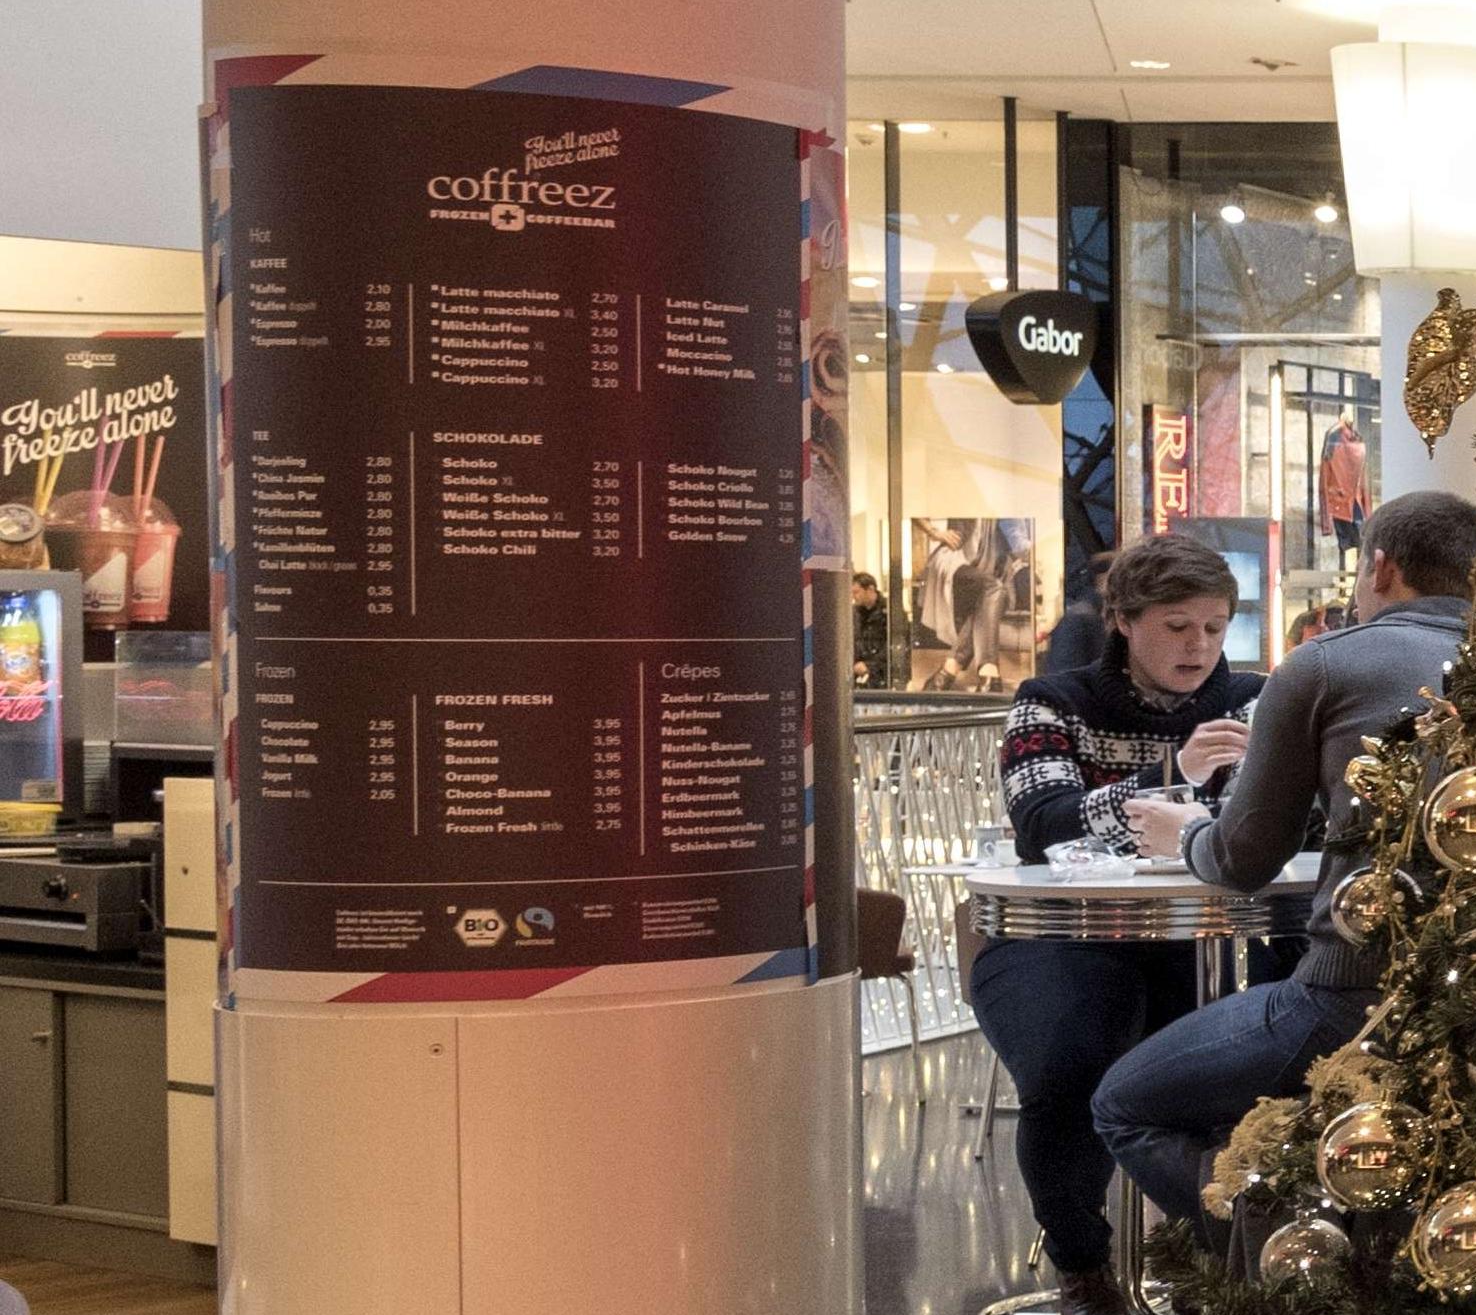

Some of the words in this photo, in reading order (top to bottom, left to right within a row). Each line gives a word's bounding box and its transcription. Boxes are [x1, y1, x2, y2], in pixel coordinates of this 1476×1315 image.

[427, 167, 617, 209] coffreez
[430, 208, 490, 221] FROZEN
[526, 213, 616, 229] COFFEEBAR
[250, 227, 272, 243] Hot
[250, 258, 288, 269] KAFFEE
[441, 286, 479, 298] Latte
[484, 287, 560, 301] macchiato
[666, 298, 699, 309] Latte
[441, 303, 479, 315] Latte
[484, 304, 560, 318] macchiato
[441, 319, 530, 334] Milchkaffee
[666, 315, 699, 326] Latte
[667, 331, 694, 342] Iced
[697, 333, 729, 345] Latte
[1018, 316, 1083, 357] Gabor
[441, 336, 530, 351] Milchkaffee
[441, 354, 529, 370] Cappuccino
[441, 371, 529, 387] Cappuccino
[1, 387, 103, 435] You'll
[105, 374, 178, 416] never
[2, 425, 98, 476] freeze
[102, 405, 177, 444] alone
[433, 432, 543, 445] SCHOKOLADE
[442, 457, 497, 470] Schoko
[668, 464, 715, 475] Schoko
[442, 474, 497, 487] Schoko
[668, 480, 715, 491] Schoko
[442, 492, 489, 504] Weiße
[493, 493, 549, 505] Schoko
[668, 497, 715, 508] Schoko
[442, 509, 489, 521] Weiße
[493, 510, 549, 522] Schoko
[668, 514, 715, 524] Schoko
[442, 526, 497, 539] Schoko
[500, 528, 539, 539] extra
[541, 528, 583, 539] bitter
[442, 543, 498, 555] Schoko
[502, 543, 537, 555] Chili
[255, 662, 296, 679] Frozen
[661, 662, 721, 680] Crêpes
[436, 695, 497, 706] FROZEN
[502, 694, 553, 705] FRESH
[662, 710, 722, 722] Apfelmus
[445, 720, 485, 733] Berry
[662, 726, 707, 736] Nutella
[445, 737, 498, 749] Season
[445, 754, 498, 766] Banana
[445, 772, 498, 784] Orange
[445, 788, 551, 800] Choco-Banana
[662, 791, 741, 803] Erdbeermark
[446, 805, 504, 816] Almond
[662, 807, 743, 819] Himbeermark
[446, 823, 494, 834] Frozen
[497, 822, 538, 833] Fresh
